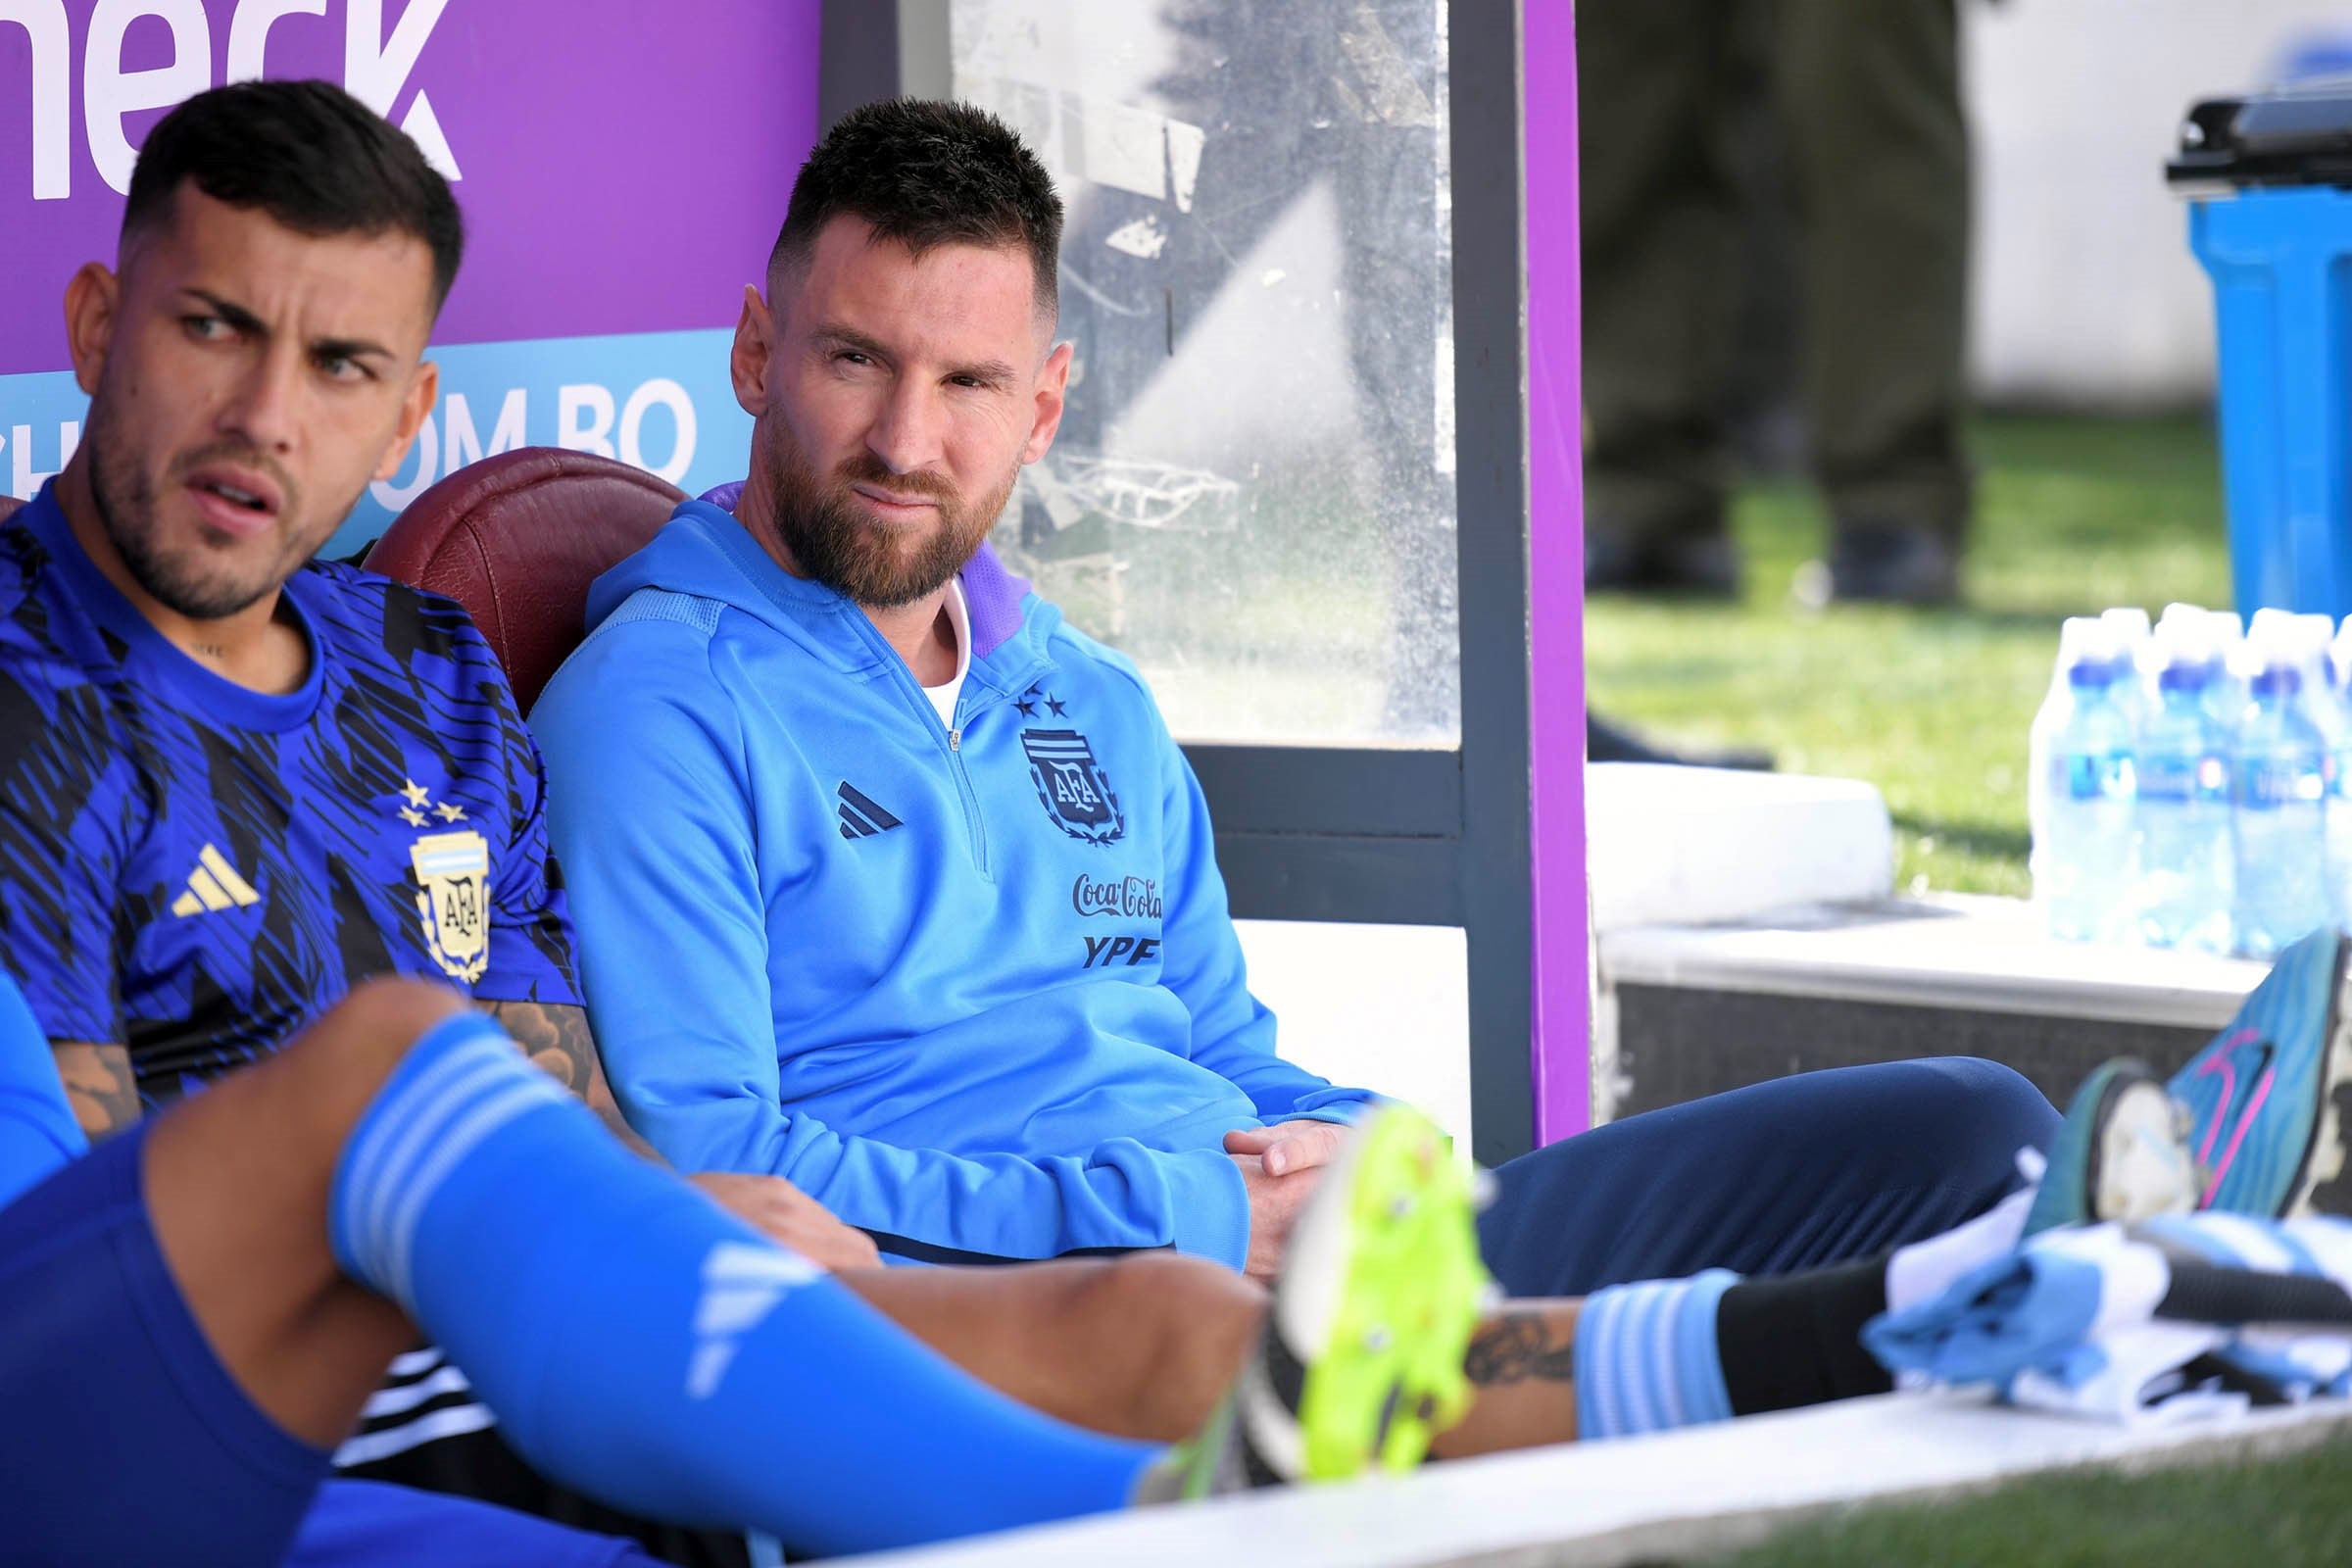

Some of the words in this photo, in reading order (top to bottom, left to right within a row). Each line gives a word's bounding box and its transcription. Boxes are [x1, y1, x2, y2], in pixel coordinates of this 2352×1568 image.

[559, 378, 697, 487] BO
[1049, 760, 1102, 812] AFA
[444, 875, 478, 938] AFA
[1072, 873, 1162, 919] Coca-Cola
[1082, 936, 1161, 969] YPF
